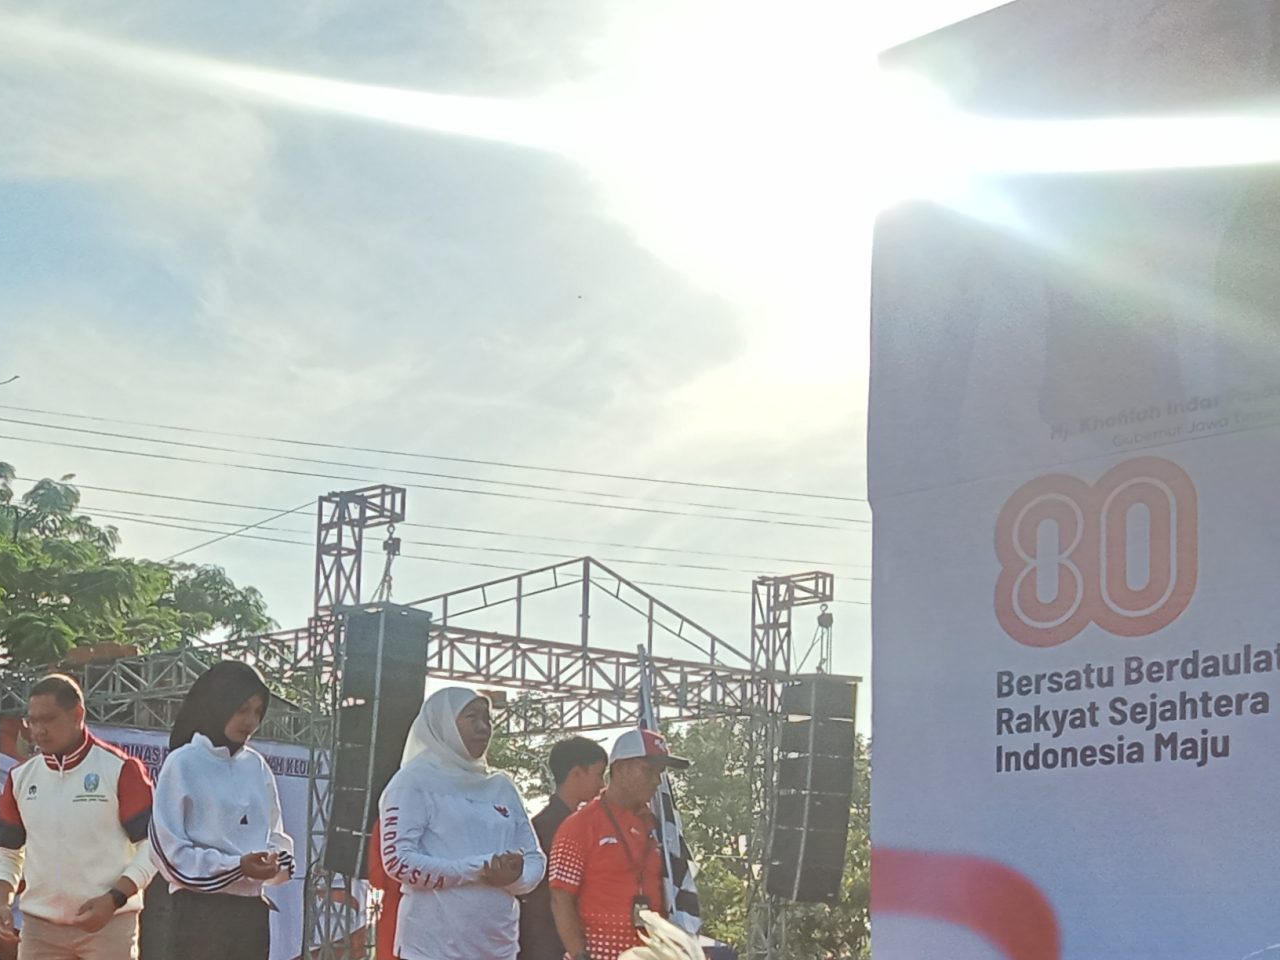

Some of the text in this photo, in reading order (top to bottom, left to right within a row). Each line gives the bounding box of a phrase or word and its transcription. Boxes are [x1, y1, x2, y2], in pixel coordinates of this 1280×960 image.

[1189, 414, 1230, 435] Jawa
[994, 456, 1198, 648] 80
[996, 662, 1116, 699] Bersatu
[996, 689, 1271, 739] Rakyat Sejahtera
[996, 728, 1231, 773] Indonesia Maju
[383, 806, 446, 890] INDONESIA
